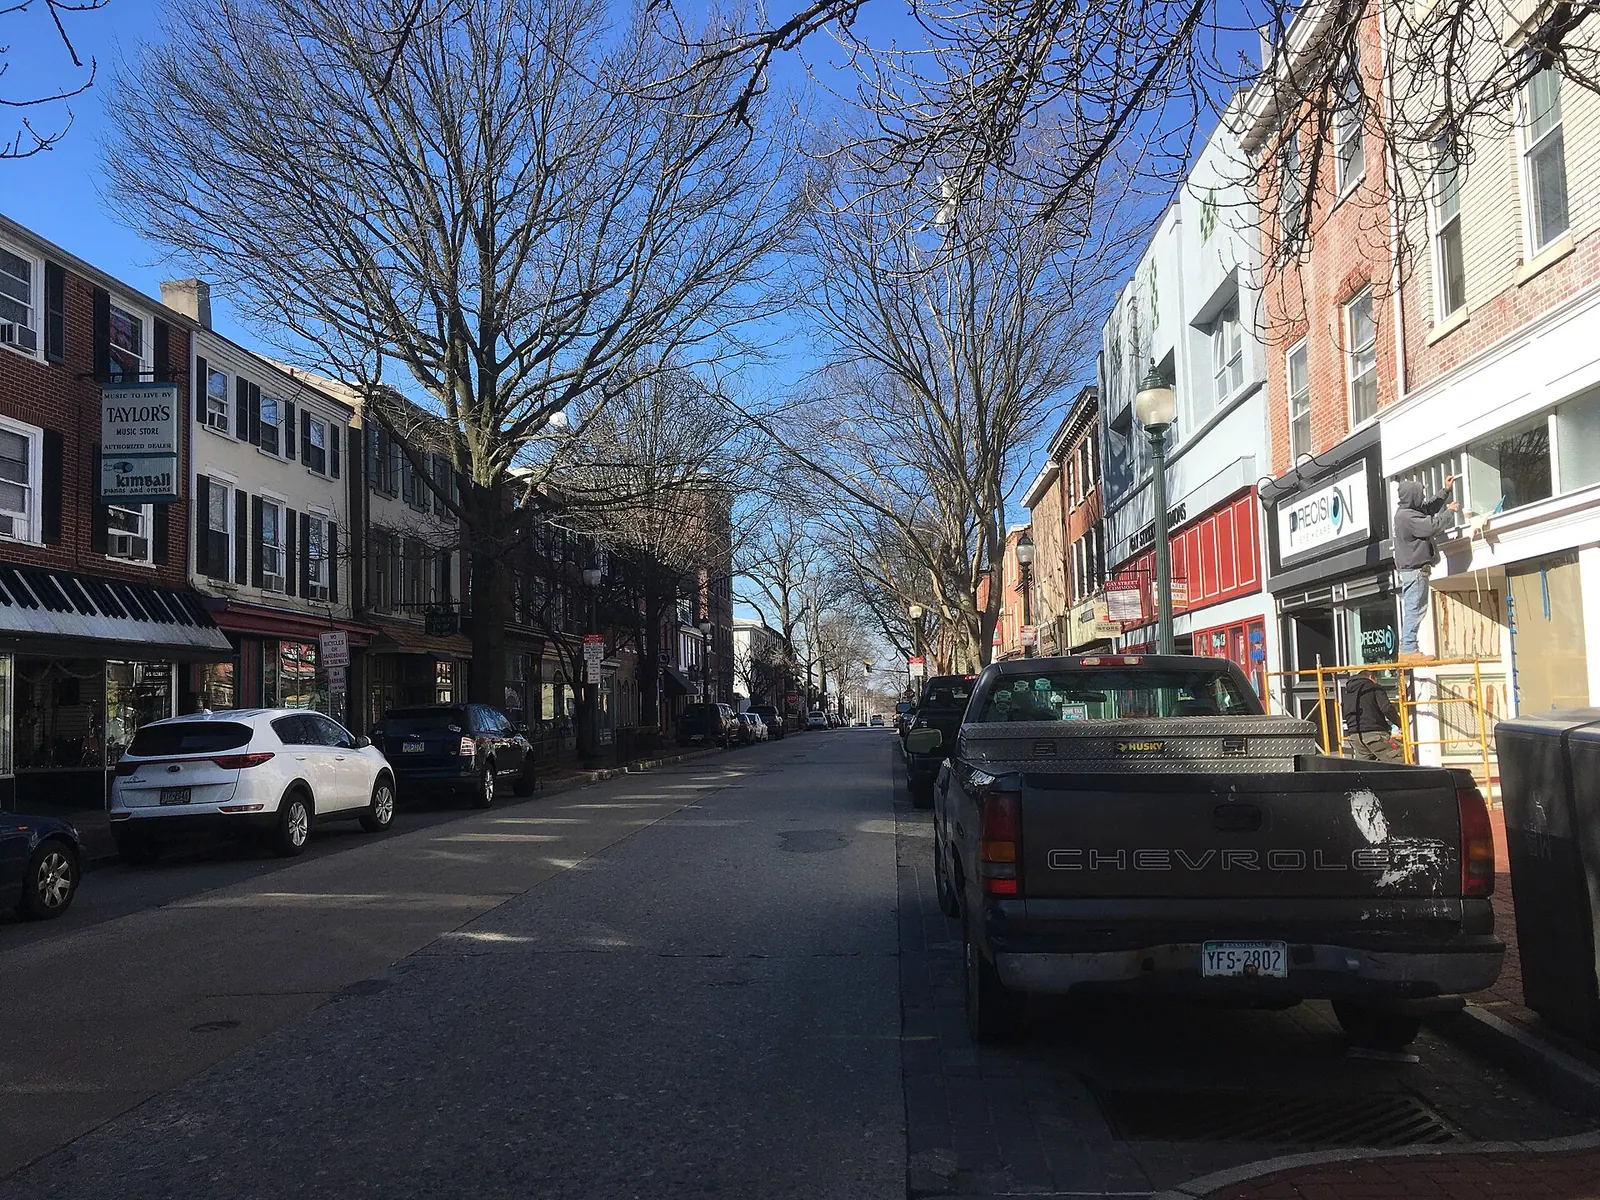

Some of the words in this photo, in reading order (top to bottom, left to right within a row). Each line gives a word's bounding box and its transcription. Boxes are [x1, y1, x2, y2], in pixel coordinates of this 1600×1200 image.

[106, 404, 170, 422] TAYLOR'S
[116, 428, 136, 436] MUSIC
[140, 427, 159, 435] STORE
[1289, 485, 1353, 547] PRECISION
[1129, 742, 1163, 751] HUSKY
[1207, 950, 1282, 971] YFS-2802
